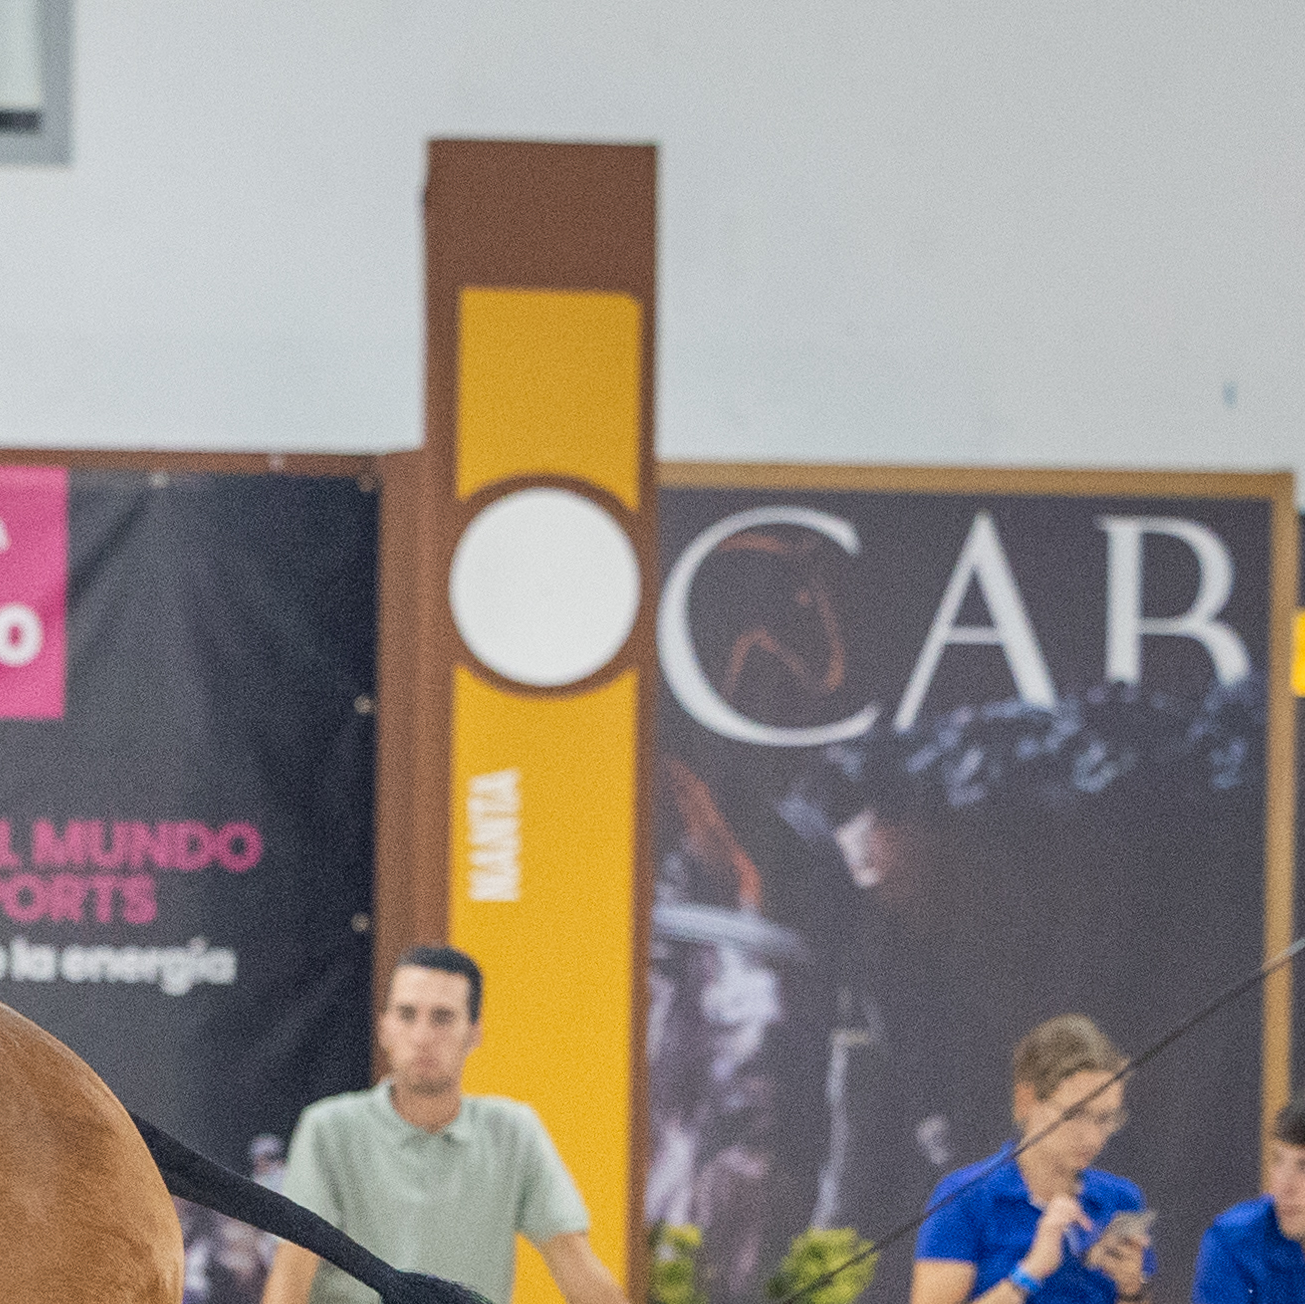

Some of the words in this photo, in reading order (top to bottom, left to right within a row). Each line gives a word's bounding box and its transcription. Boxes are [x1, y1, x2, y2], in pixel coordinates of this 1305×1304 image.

[32, 819, 263, 873] MUNDO
[11, 935, 56, 983] la
[61, 935, 238, 997] energía
